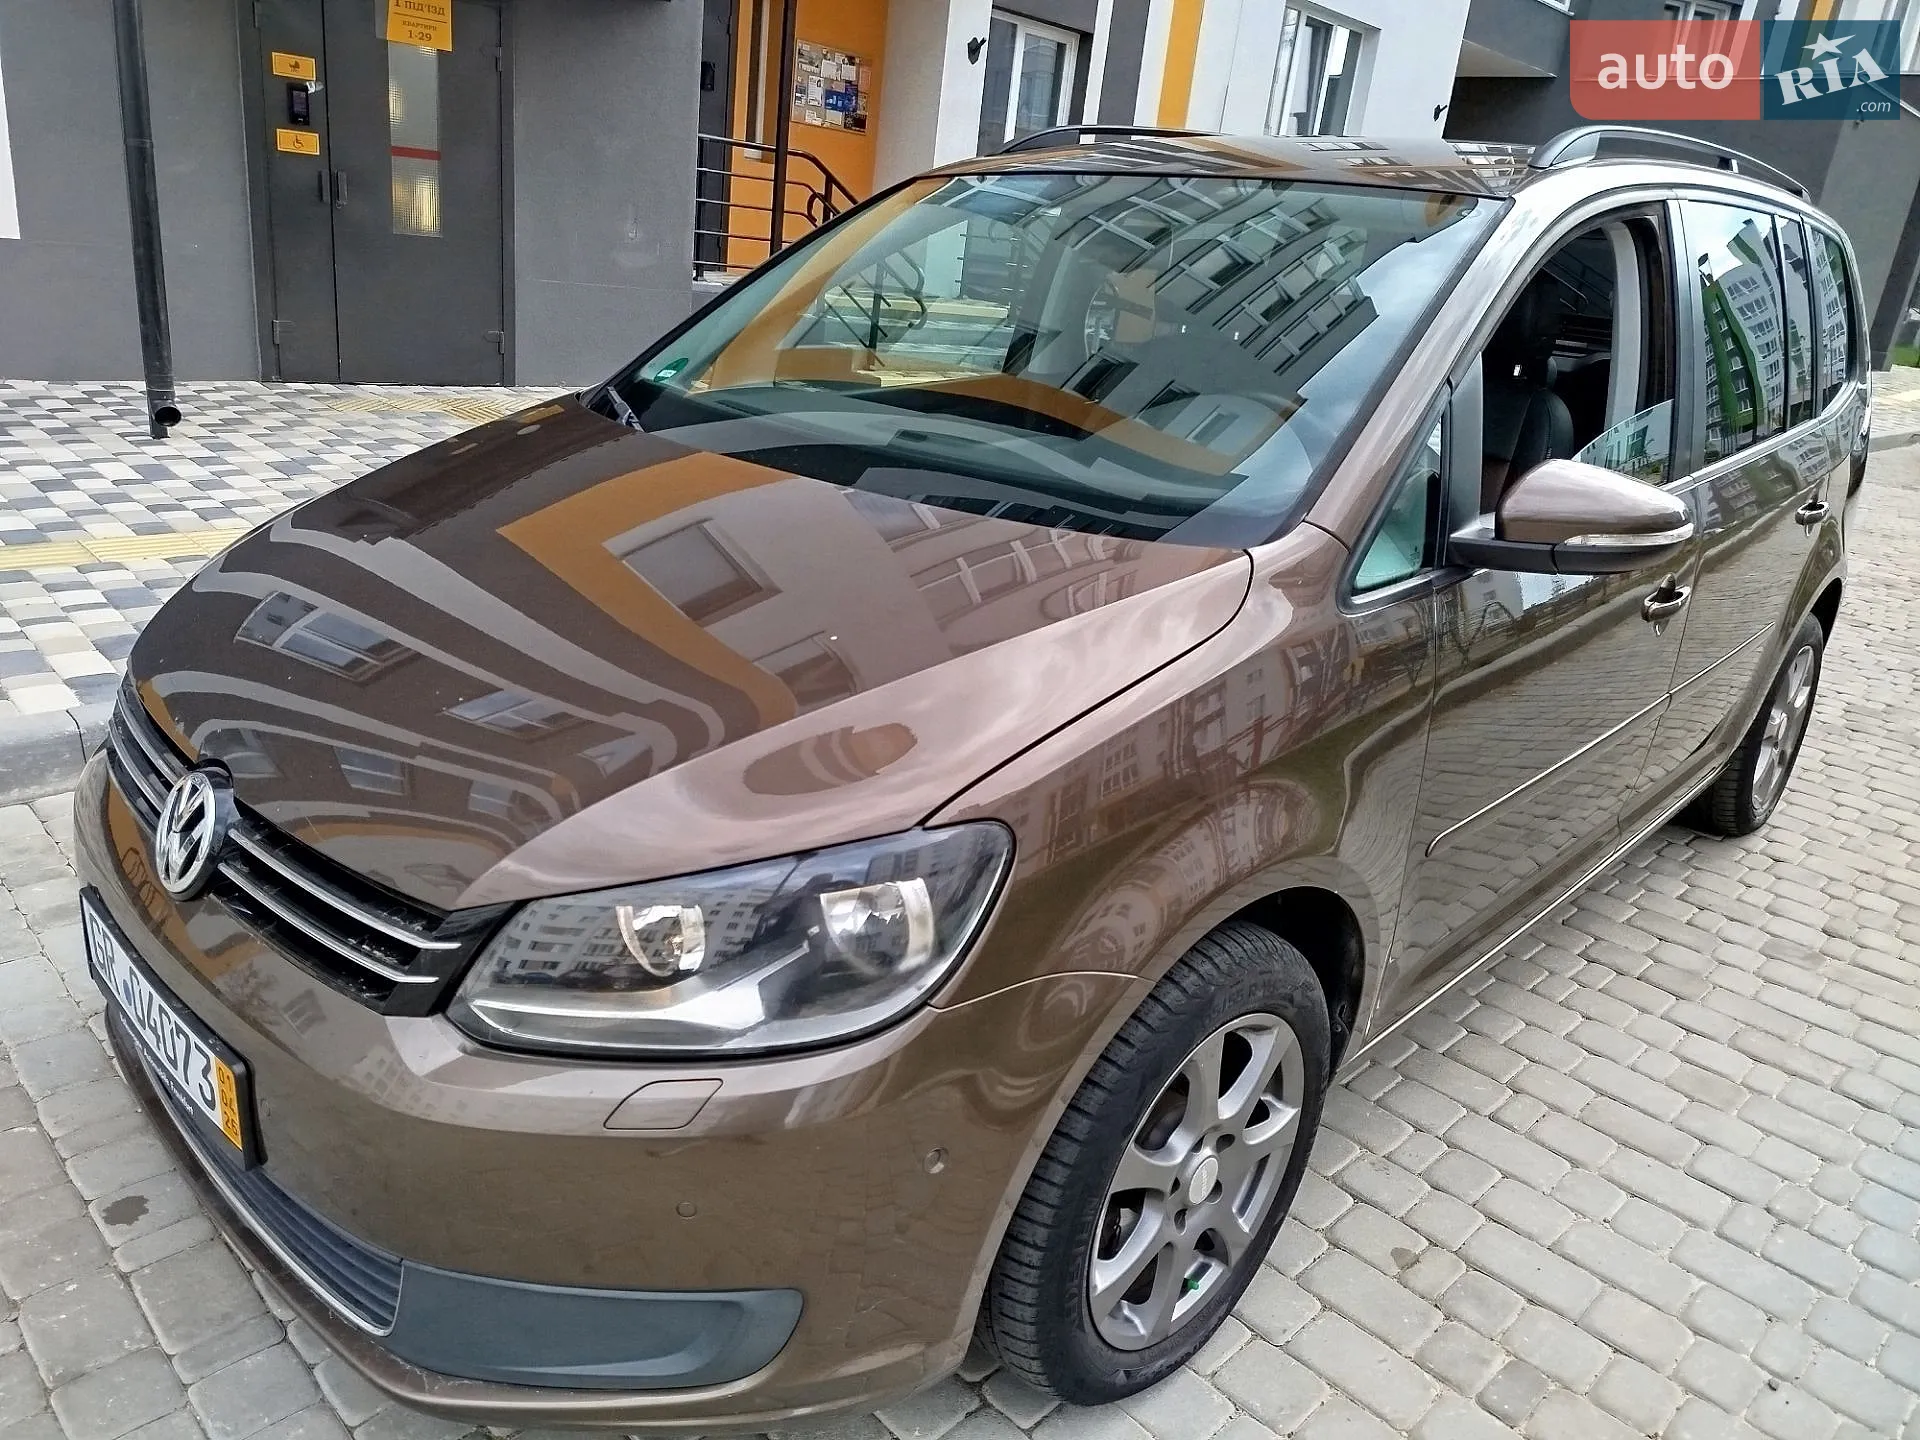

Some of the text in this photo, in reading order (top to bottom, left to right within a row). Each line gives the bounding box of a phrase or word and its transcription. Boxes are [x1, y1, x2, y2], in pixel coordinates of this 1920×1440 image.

[402, 20, 437, 31] КВАРТИРИ
[408, 30, 432, 41] 1-29
[89, 912, 120, 996] GR
[128, 965, 217, 1111] 04073
